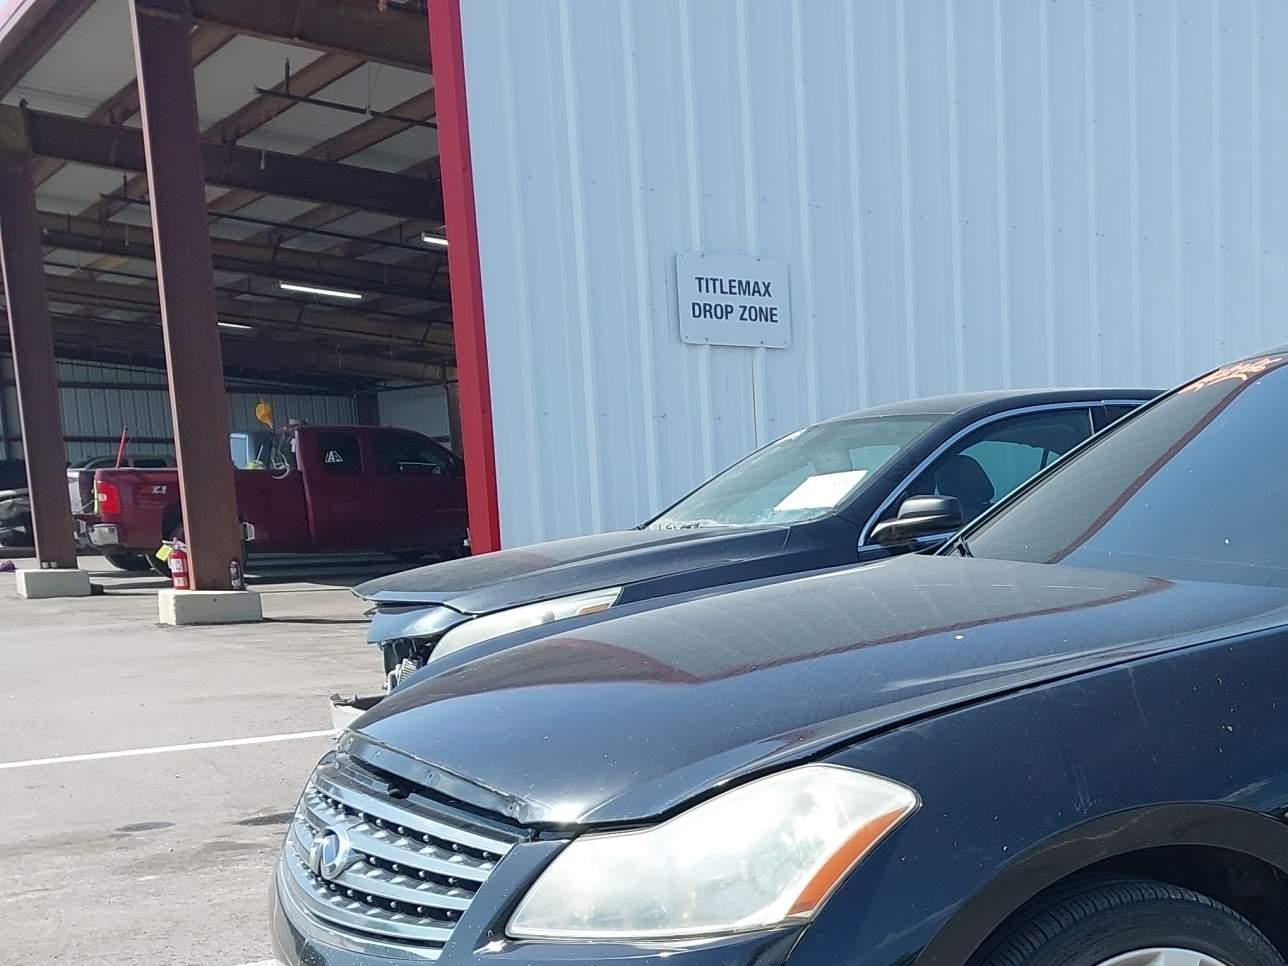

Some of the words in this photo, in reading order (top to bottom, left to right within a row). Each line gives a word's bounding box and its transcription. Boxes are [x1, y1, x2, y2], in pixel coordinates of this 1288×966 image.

[694, 276, 772, 298] TITLEMAX
[691, 302, 734, 320] DROP
[738, 305, 779, 323] ZONE
